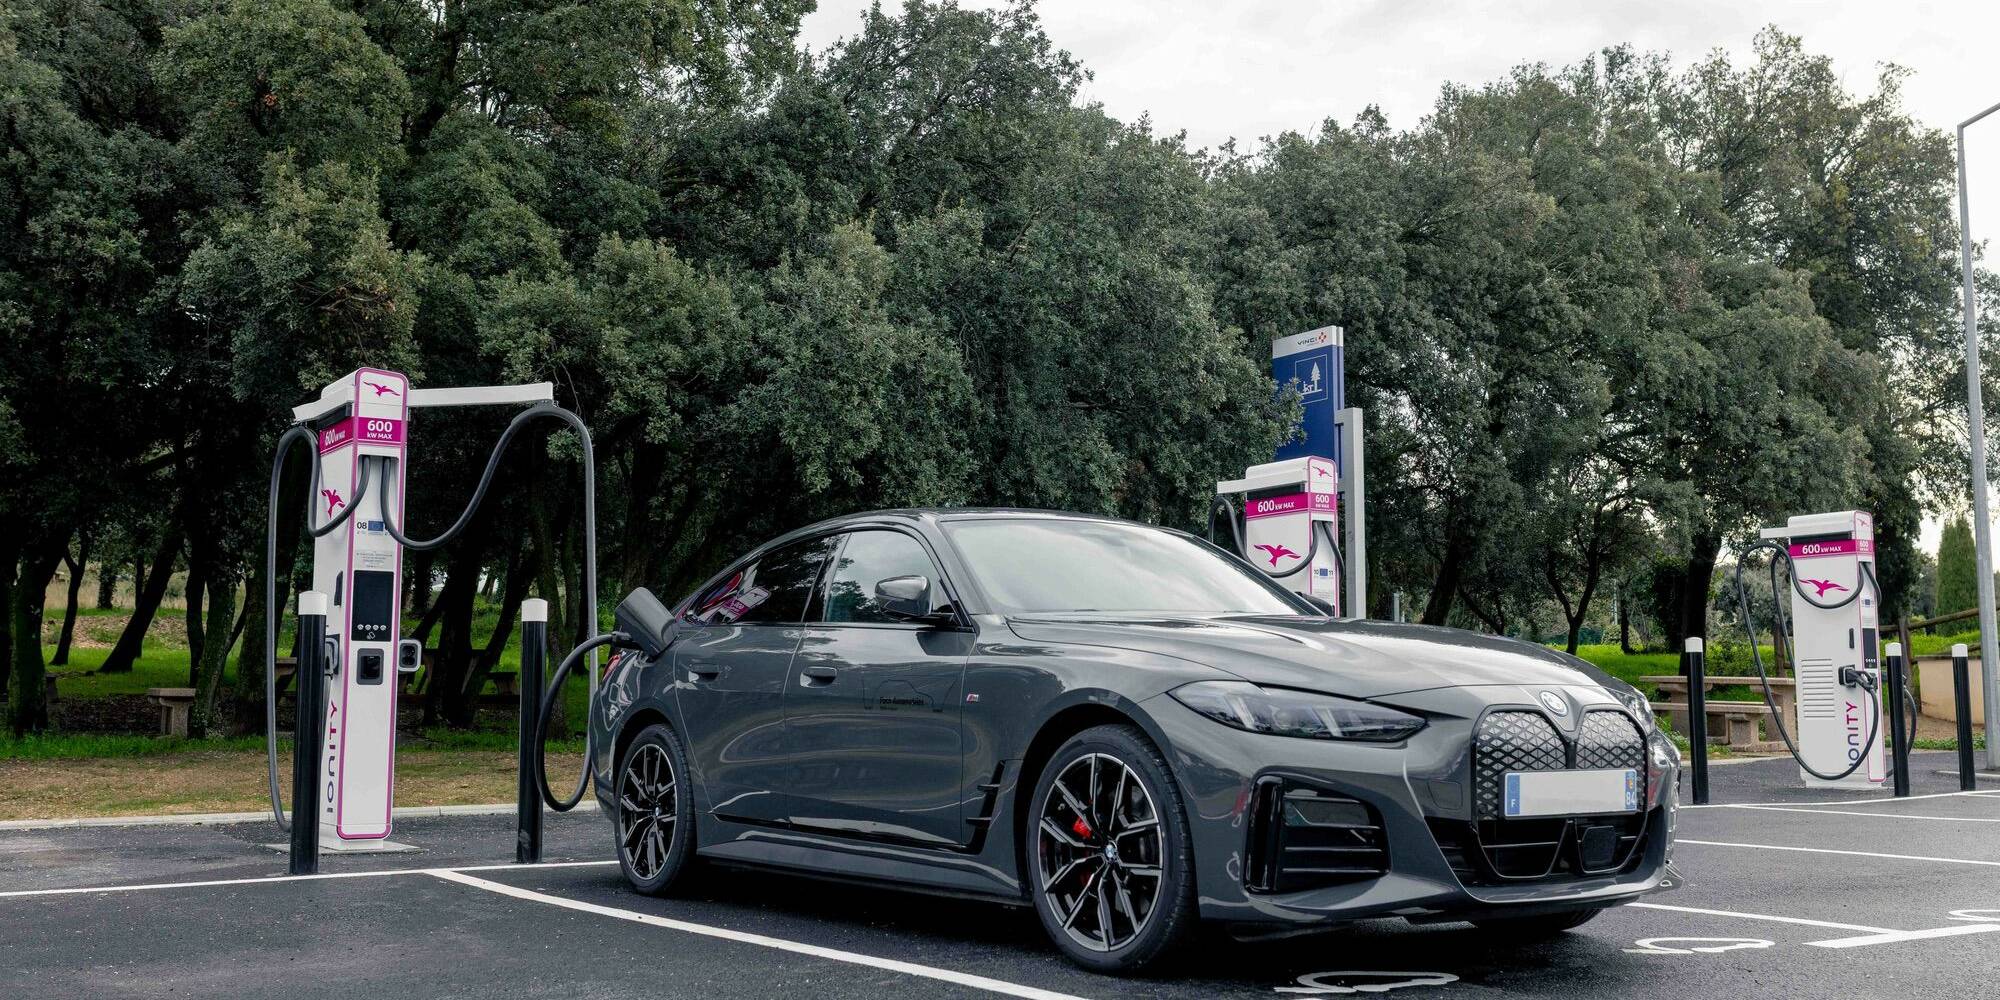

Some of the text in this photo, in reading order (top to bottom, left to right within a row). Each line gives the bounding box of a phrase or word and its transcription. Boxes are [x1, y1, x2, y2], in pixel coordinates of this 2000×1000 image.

[1297, 337, 1317, 345] VINCI
[368, 420, 393, 433] 600
[325, 428, 336, 446] 600
[1315, 494, 1329, 504] 600
[1258, 500, 1275, 512] 600
[1283, 501, 1295, 509] MAX
[356, 521, 367, 529] 08
[1802, 544, 1820, 554] 600
[326, 700, 338, 813] IONITY
[1511, 799, 1516, 807] F
[1626, 791, 1635, 806] 84
